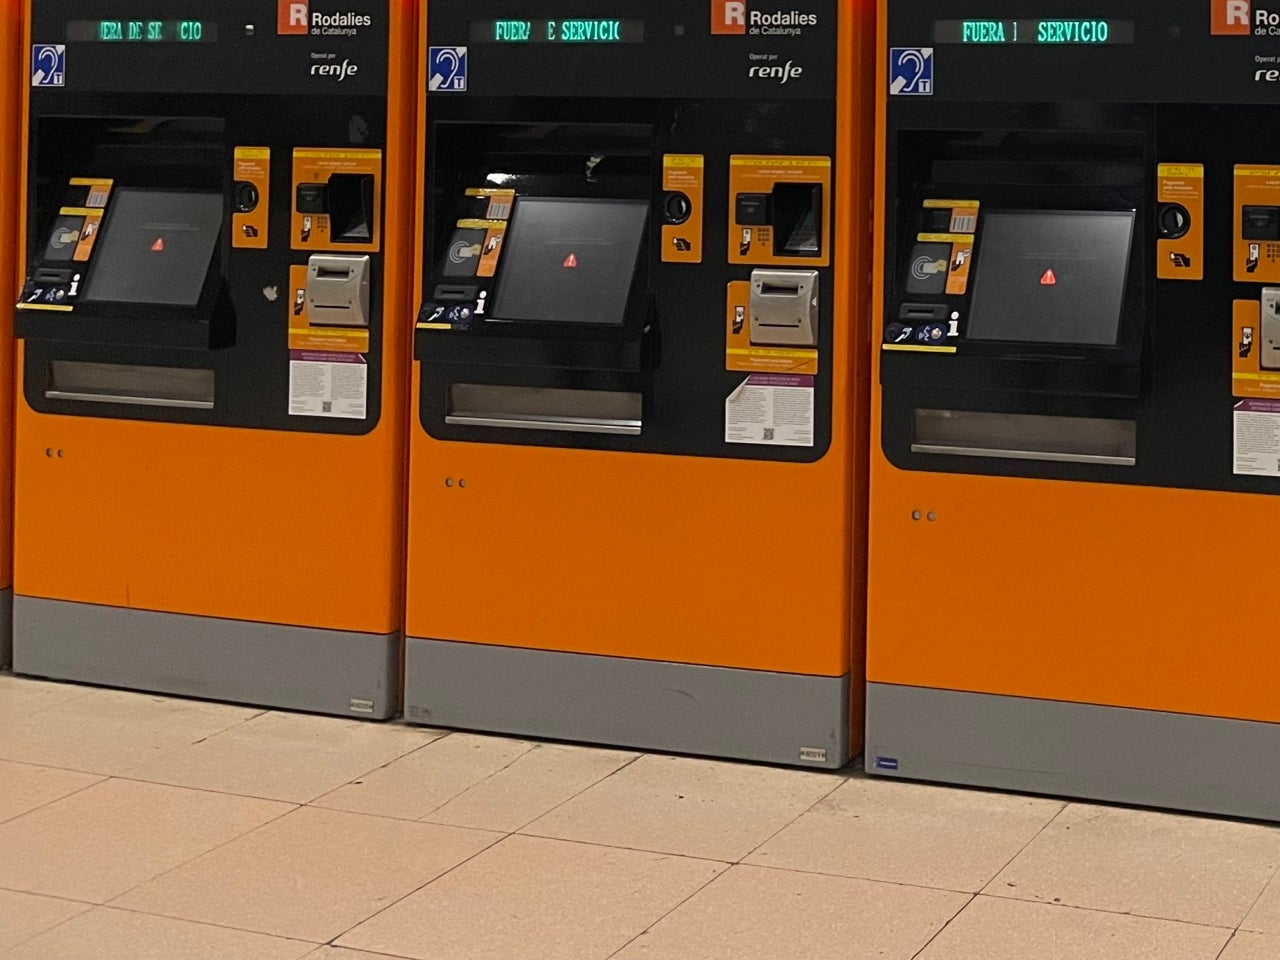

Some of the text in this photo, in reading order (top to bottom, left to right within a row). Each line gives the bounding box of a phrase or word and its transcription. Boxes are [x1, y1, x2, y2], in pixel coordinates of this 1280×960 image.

[312, 12, 372, 26] Rodalies
[725, 1, 817, 25] R Rodalies
[1226, 0, 1249, 25] R
[963, 21, 1005, 42] FUERA
[1038, 21, 1108, 42] SERVICIO
[310, 59, 358, 82] renfe
[748, 60, 803, 84] renfe
